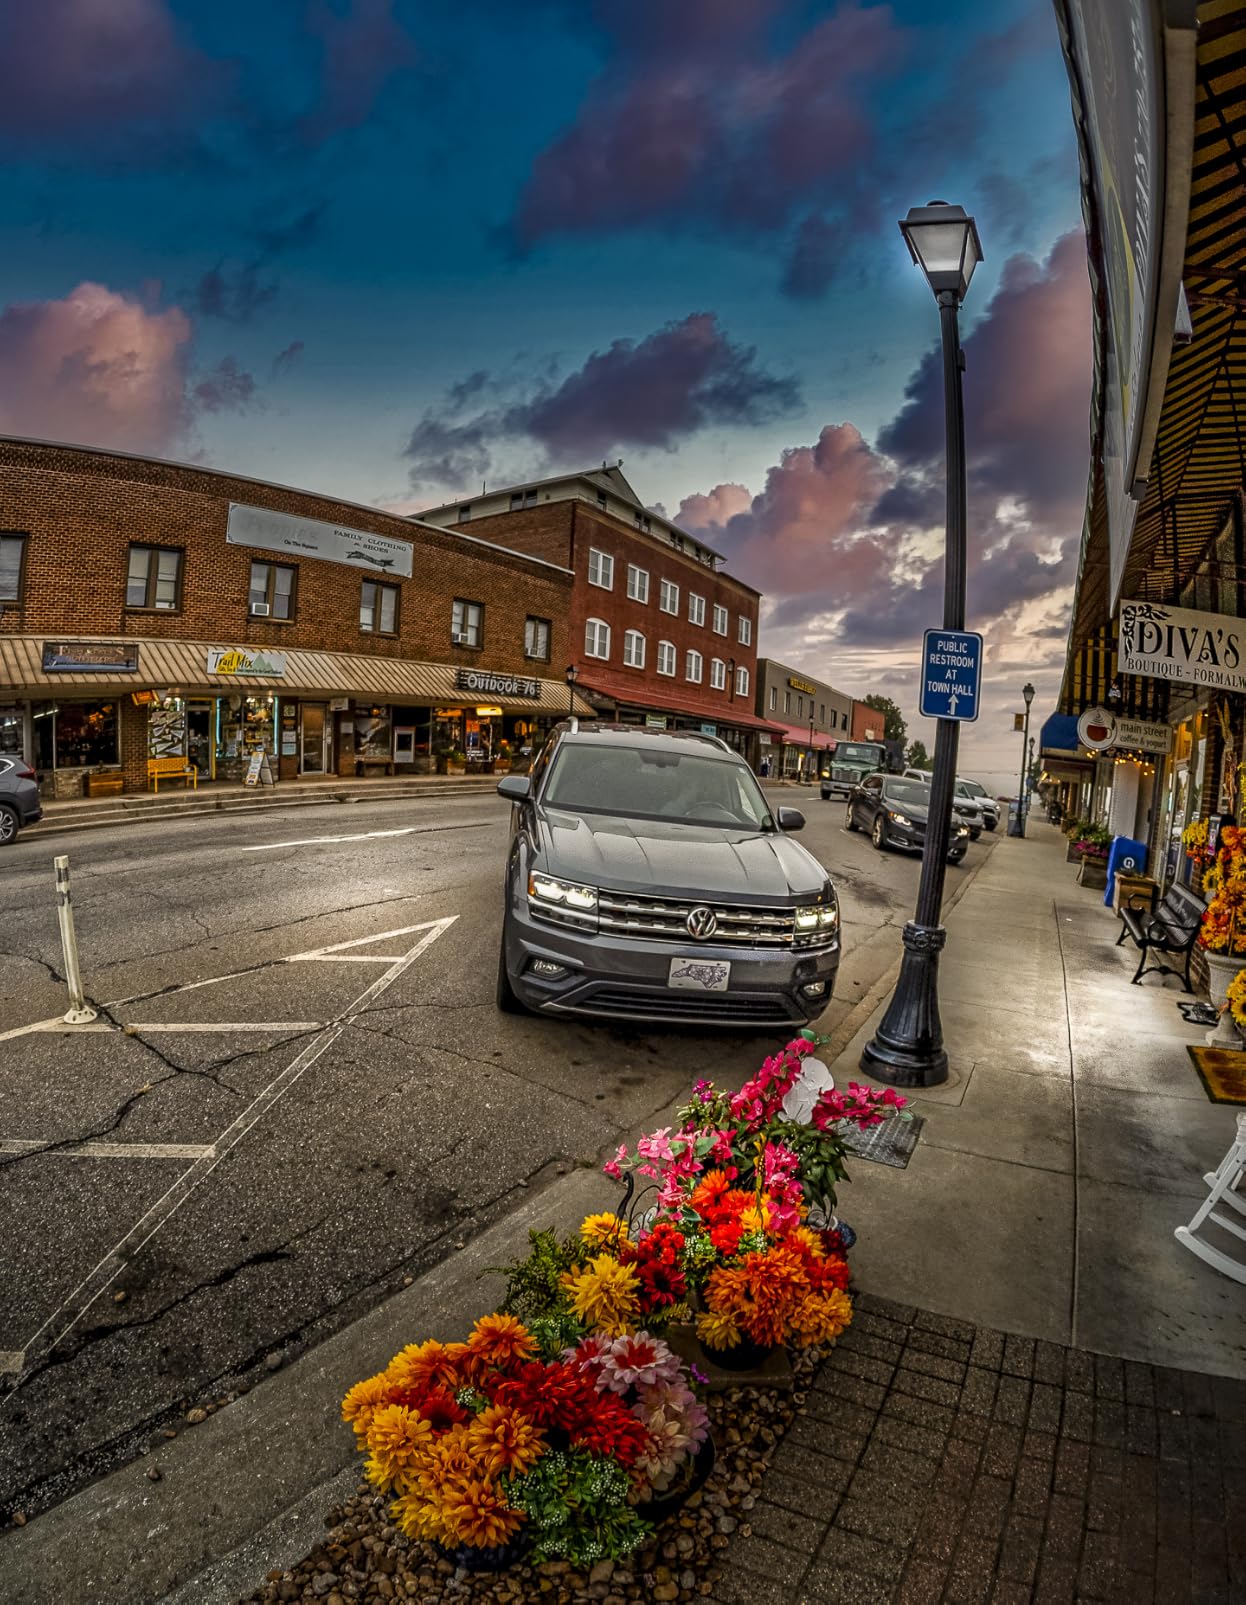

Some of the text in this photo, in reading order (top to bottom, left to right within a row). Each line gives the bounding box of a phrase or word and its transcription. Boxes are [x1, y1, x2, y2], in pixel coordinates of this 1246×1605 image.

[333, 529, 407, 552] FAMILY CLOTHING
[363, 543, 389, 554] SHOES
[937, 640, 968, 653] PUBLIC
[1136, 621, 1240, 669] DIVA'S
[212, 651, 254, 669] Trail Mix
[929, 653, 974, 669] RESTROOM
[945, 669, 957, 680] AT
[1128, 657, 1183, 679] BOUTIQUE
[523, 681, 536, 696] 76
[927, 681, 973, 697] TOWN HALL
[1120, 723, 1168, 738] main street
[1120, 735, 1138, 745] coffee
[1146, 739, 1167, 749] yogurt
